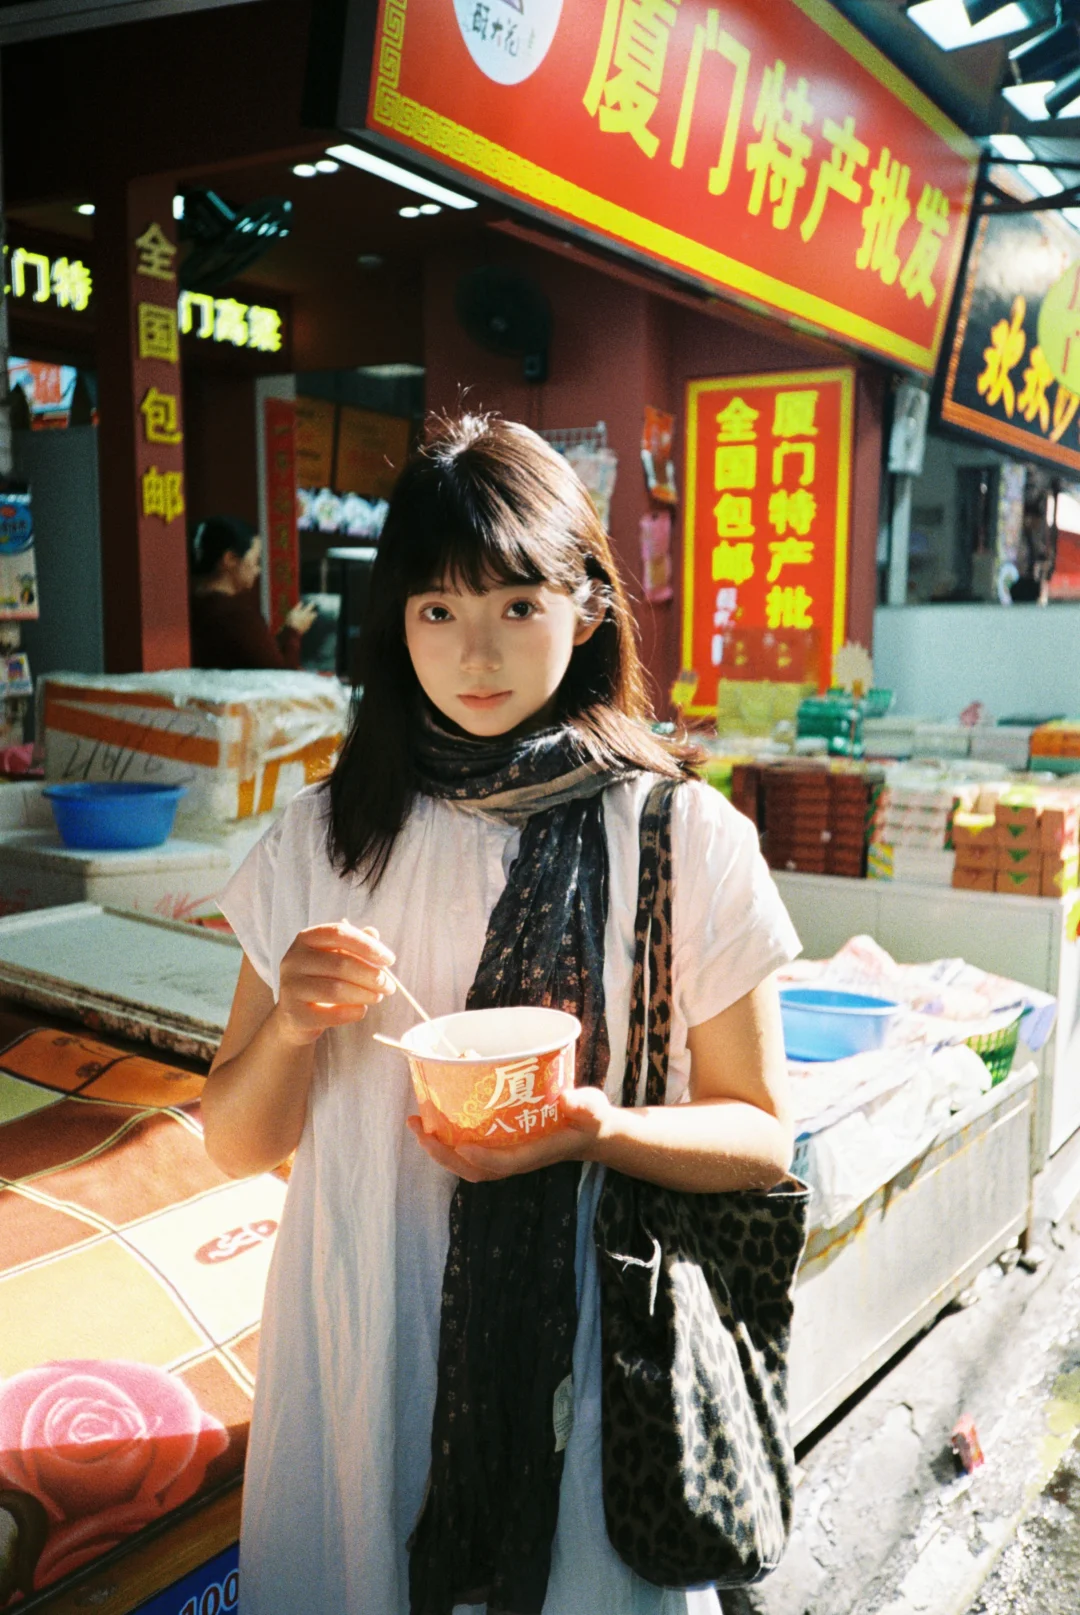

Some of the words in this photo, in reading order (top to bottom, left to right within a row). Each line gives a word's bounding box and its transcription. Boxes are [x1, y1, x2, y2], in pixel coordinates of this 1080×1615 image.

[584, 0, 951, 308] 厦门特产批发
[3, 246, 92, 311] 门特
[135, 222, 185, 525] 全国包邮
[711, 396, 760, 586] 全国包邮
[483, 1057, 546, 1110] 厦
[484, 1101, 565, 1137] 八市阿
